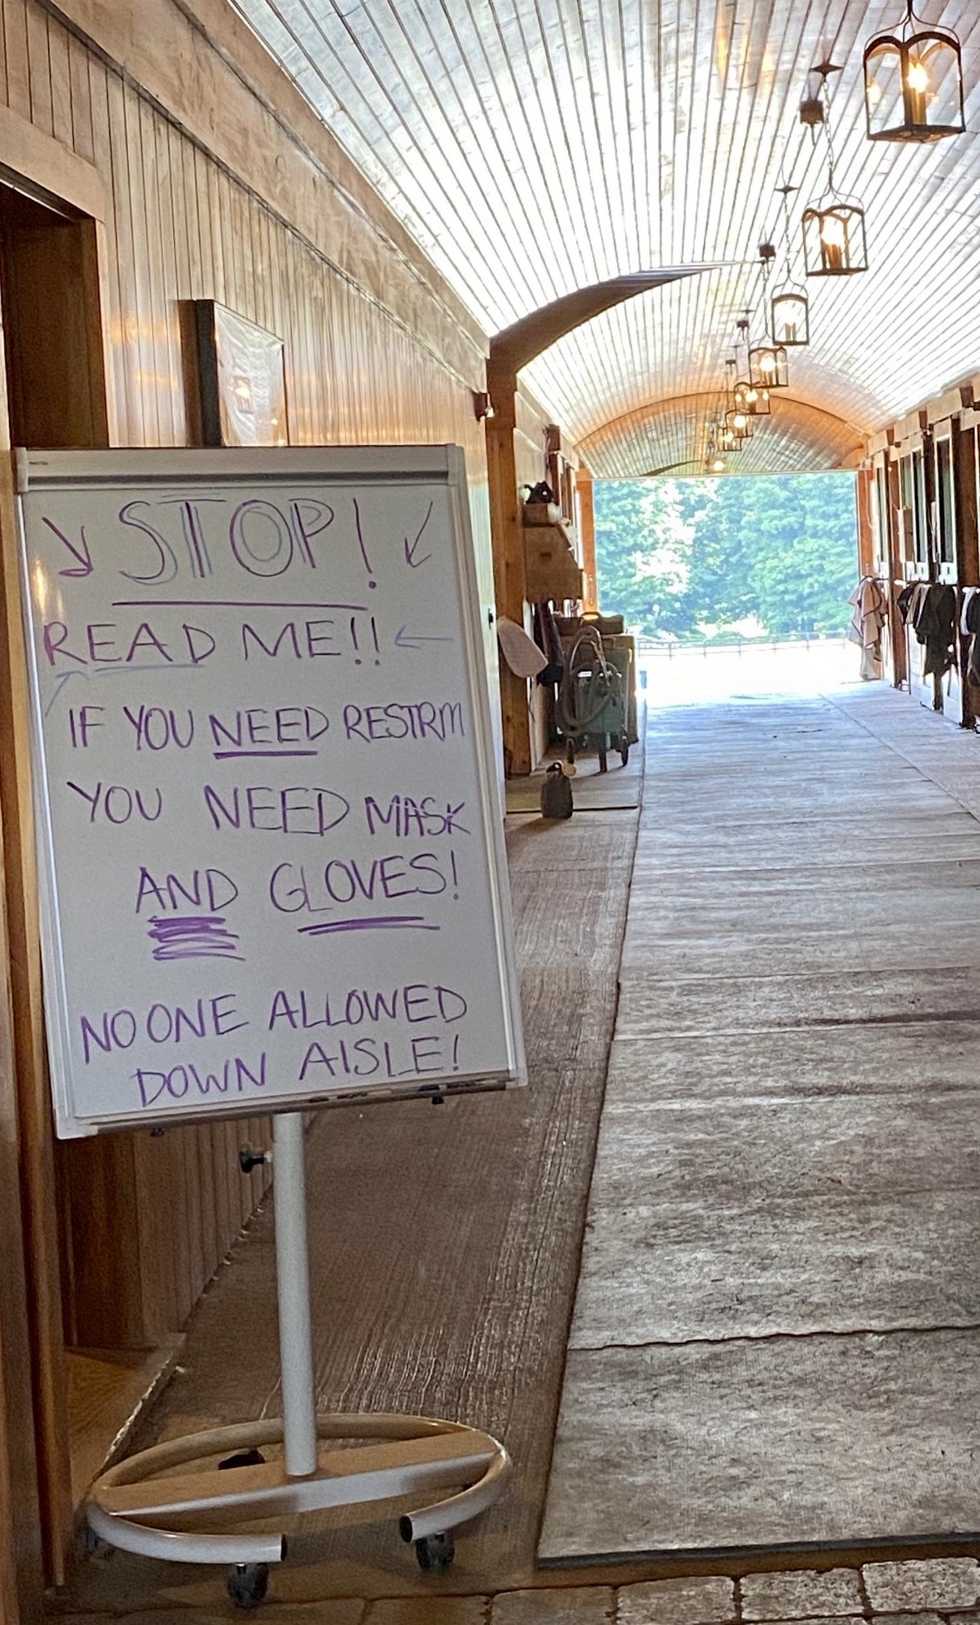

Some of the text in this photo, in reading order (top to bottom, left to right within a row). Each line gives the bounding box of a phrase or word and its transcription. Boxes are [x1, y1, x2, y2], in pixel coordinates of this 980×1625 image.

[118, 498, 377, 589] STOP!
[43, 616, 381, 666] READ ME!!
[68, 701, 465, 751] IF YOU NEED RESTRM
[67, 781, 471, 837] YOU NEED MASK
[135, 850, 460, 914] AND GLOVES!
[80, 984, 468, 1064] NO ONE ALLOWED
[131, 1034, 460, 1107] DOWN AISLE!
